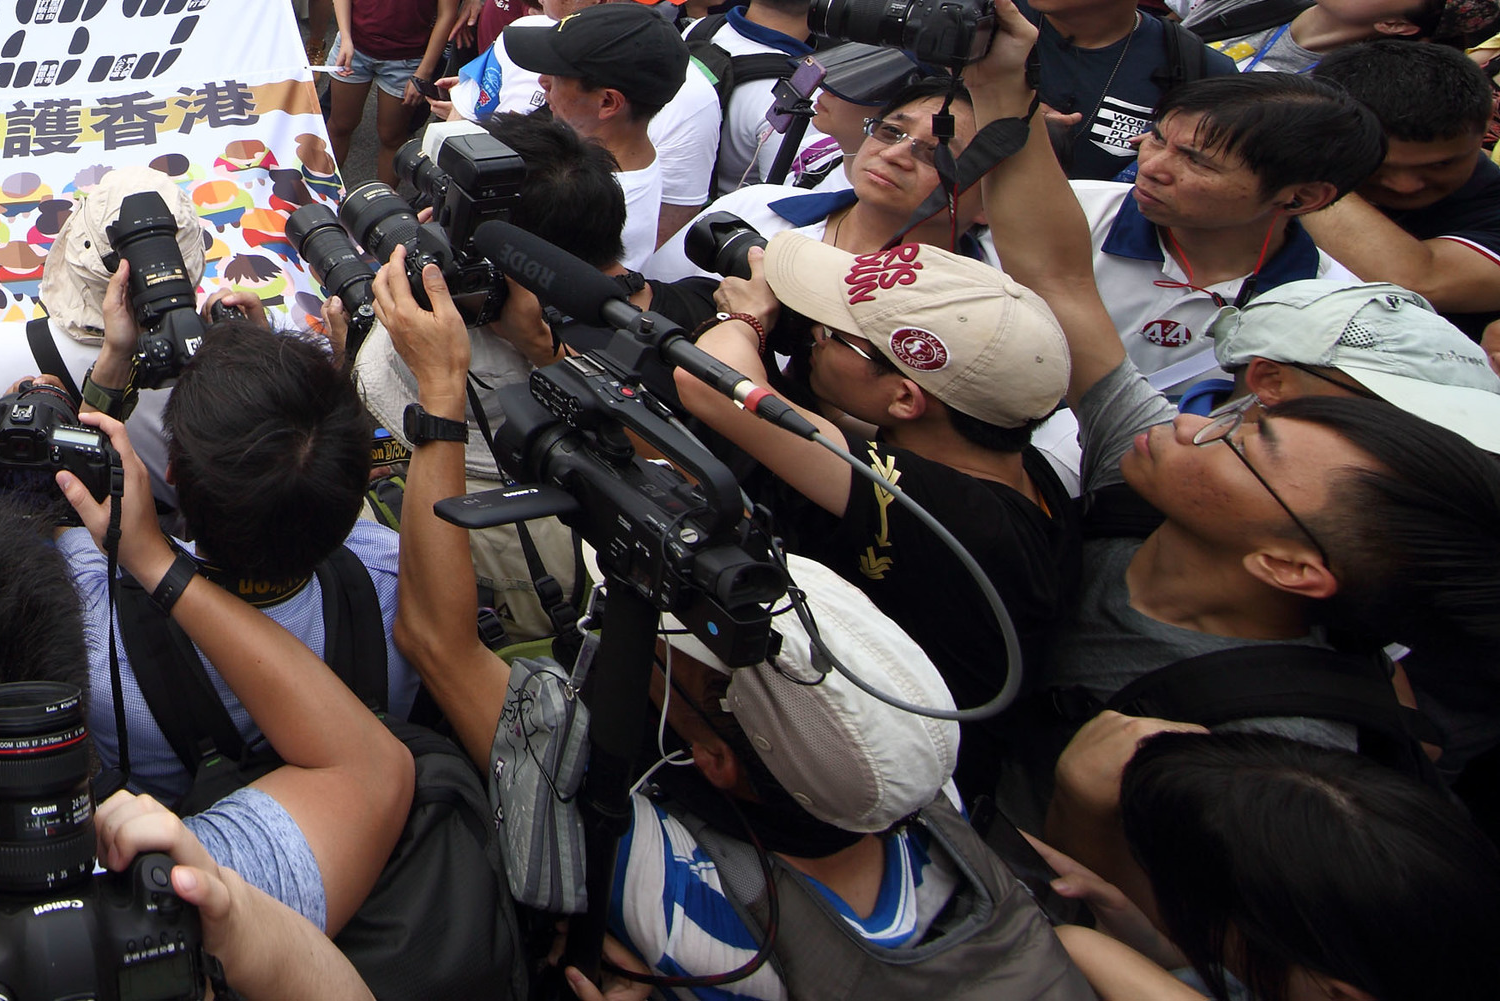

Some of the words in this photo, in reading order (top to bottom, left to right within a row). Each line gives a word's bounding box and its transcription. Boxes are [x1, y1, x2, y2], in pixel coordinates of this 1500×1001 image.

[1113, 113, 1148, 127] WOR
[1103, 136, 1132, 148] HAR
[1144, 322, 1190, 346] 44
[910, 329, 946, 363] OAKLAND
[16, 740, 30, 748] LENS
[31, 804, 58, 816] Canon
[46, 872, 55, 882] 24
[33, 899, 84, 917] Canon
